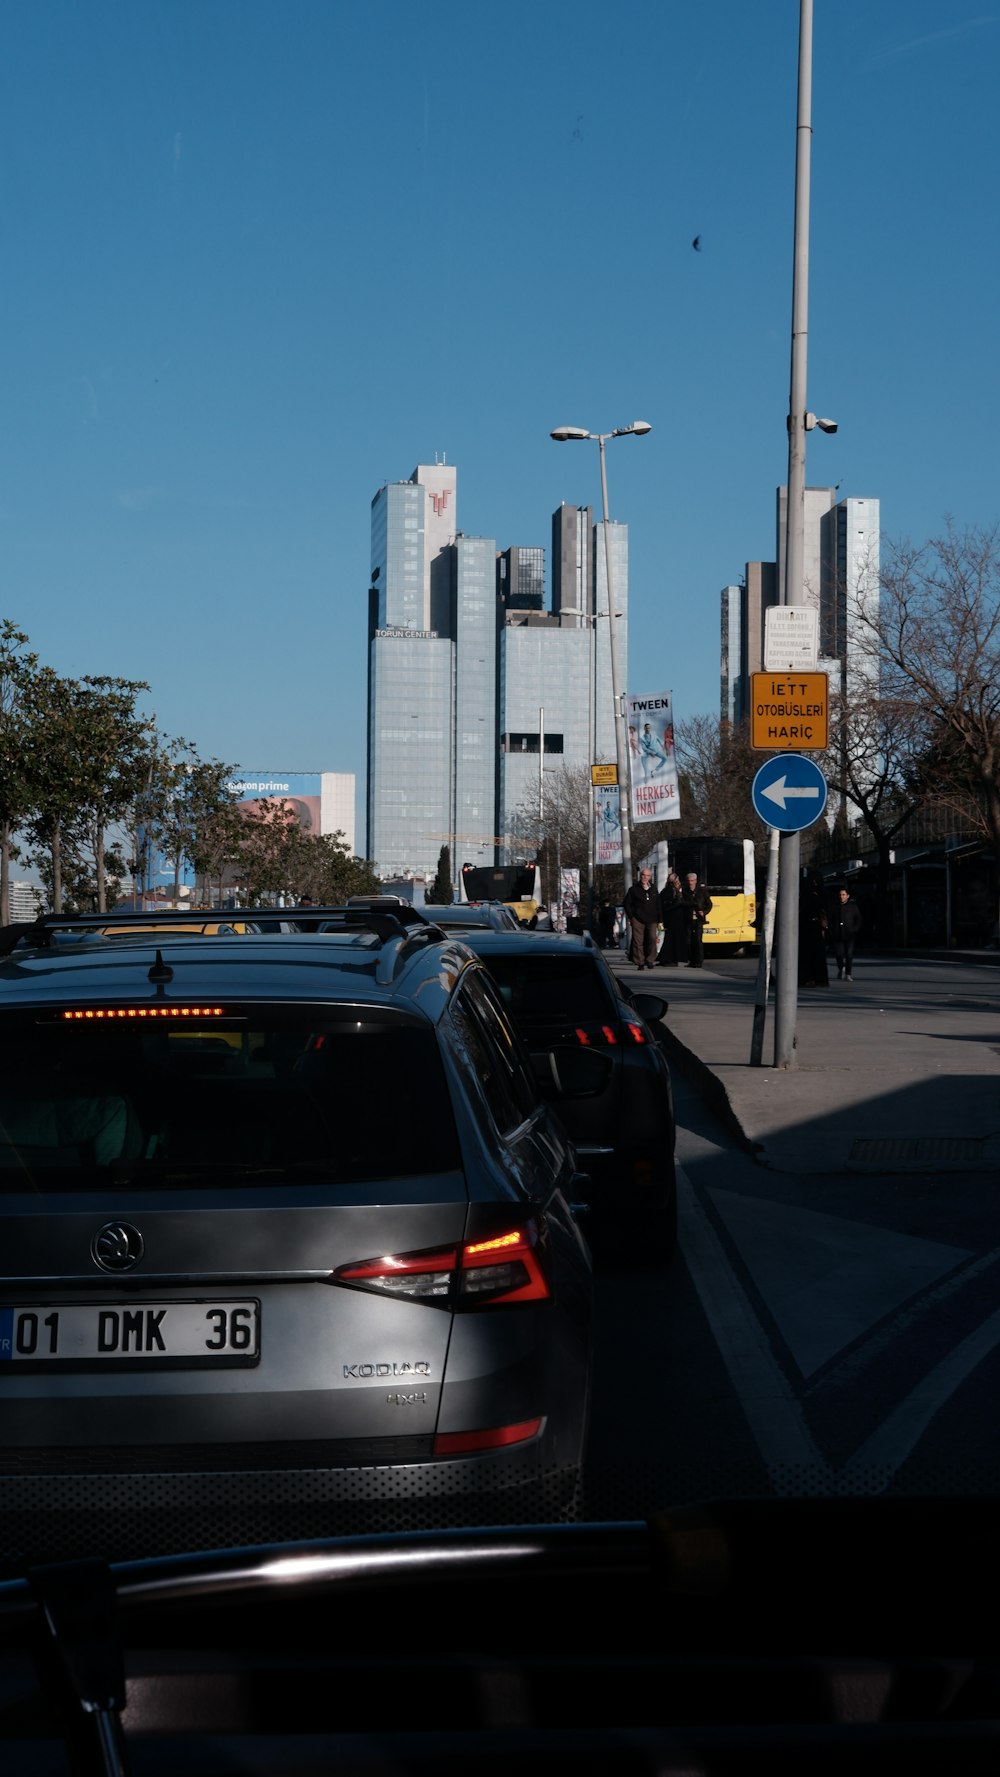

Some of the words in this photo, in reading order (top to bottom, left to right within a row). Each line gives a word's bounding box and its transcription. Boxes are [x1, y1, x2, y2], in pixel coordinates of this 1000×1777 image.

[405, 631, 438, 639] CENTER
[771, 681, 808, 696] İETT
[632, 698, 669, 712] TWEEN
[756, 701, 823, 717] OTOBÜSLERİ
[768, 724, 813, 740] HARİÇ
[258, 780, 289, 792] prime
[636, 784, 675, 801] HERKESE
[16, 1312, 59, 1355] 01
[98, 1310, 167, 1353] DMK
[205, 1308, 251, 1350] 36
[343, 1361, 431, 1379] KODIAQ
